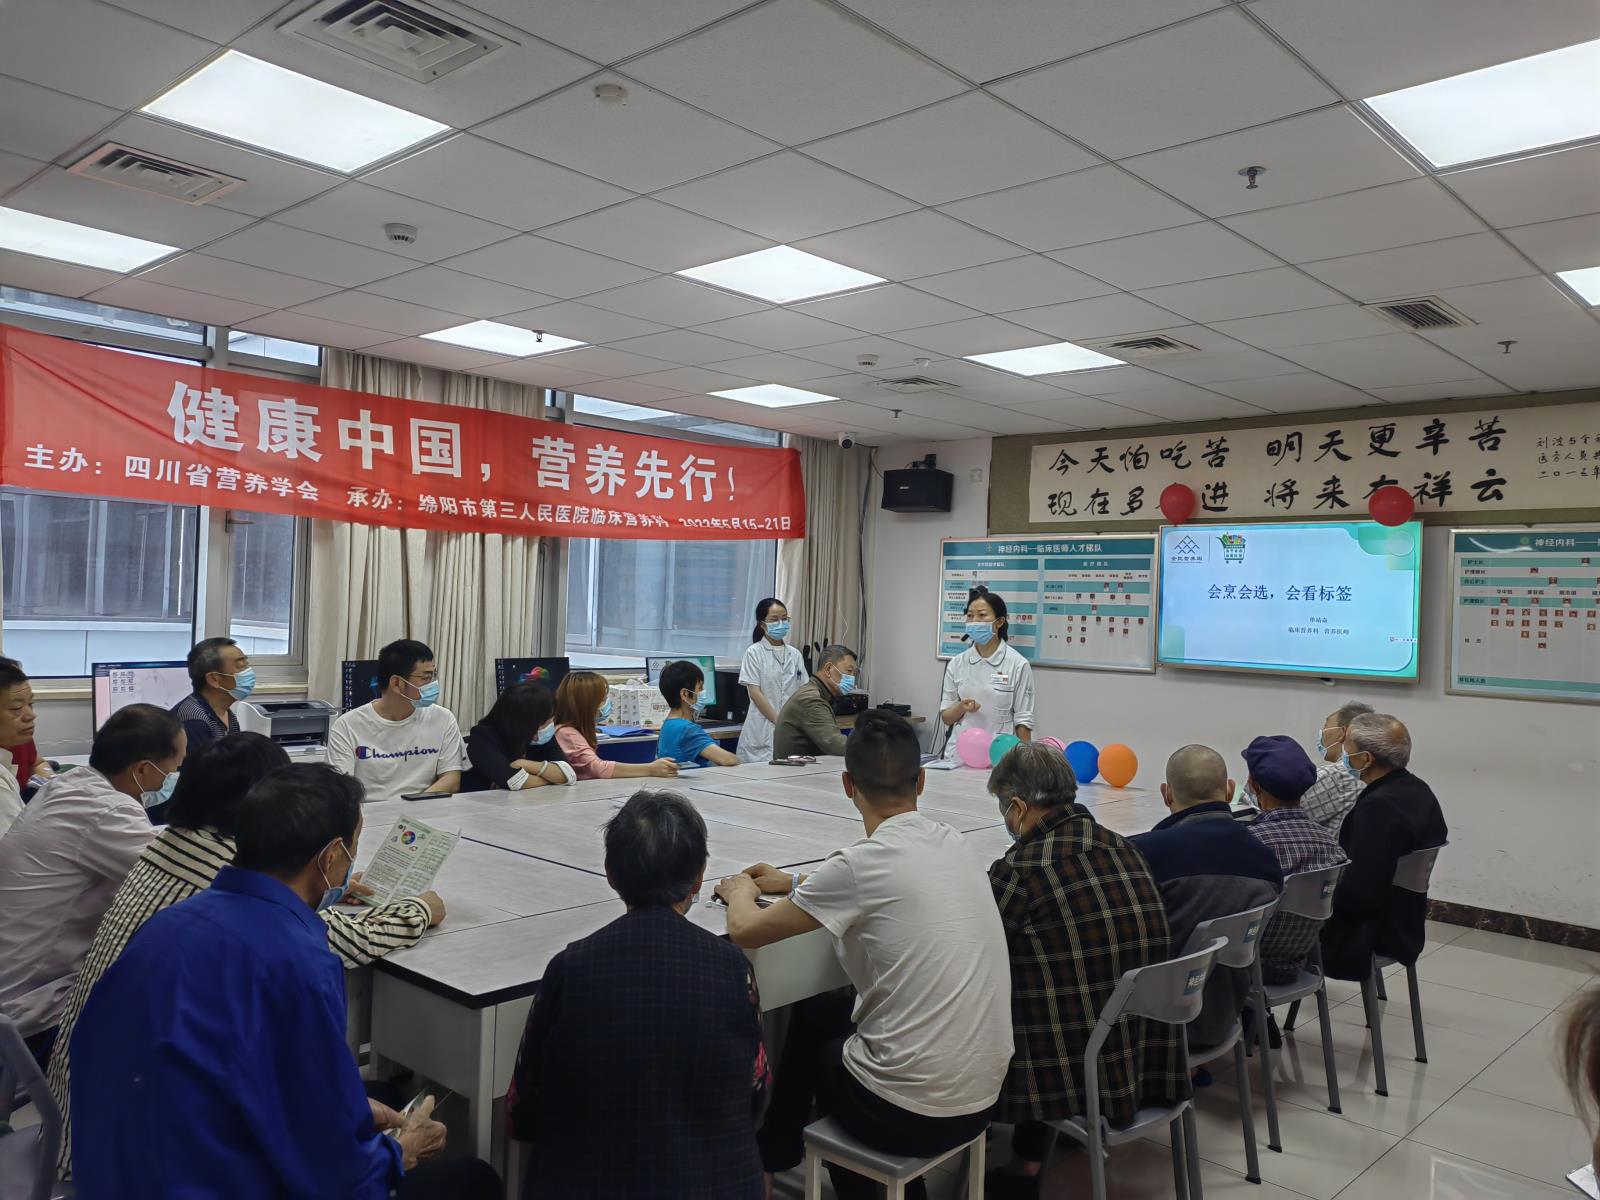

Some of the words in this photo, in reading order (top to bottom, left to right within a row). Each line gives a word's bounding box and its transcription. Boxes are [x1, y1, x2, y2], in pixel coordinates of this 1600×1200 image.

[167, 380, 735, 502] 健康中国，营养先行！
[1049, 436, 1230, 476] 今天怕吃苦
[1266, 416, 1507, 466] 明天更辛苦
[24, 443, 319, 502] 主办：四川省营养学会
[1048, 481, 1230, 516] 现在多进
[355, 746, 440, 761] Champion
